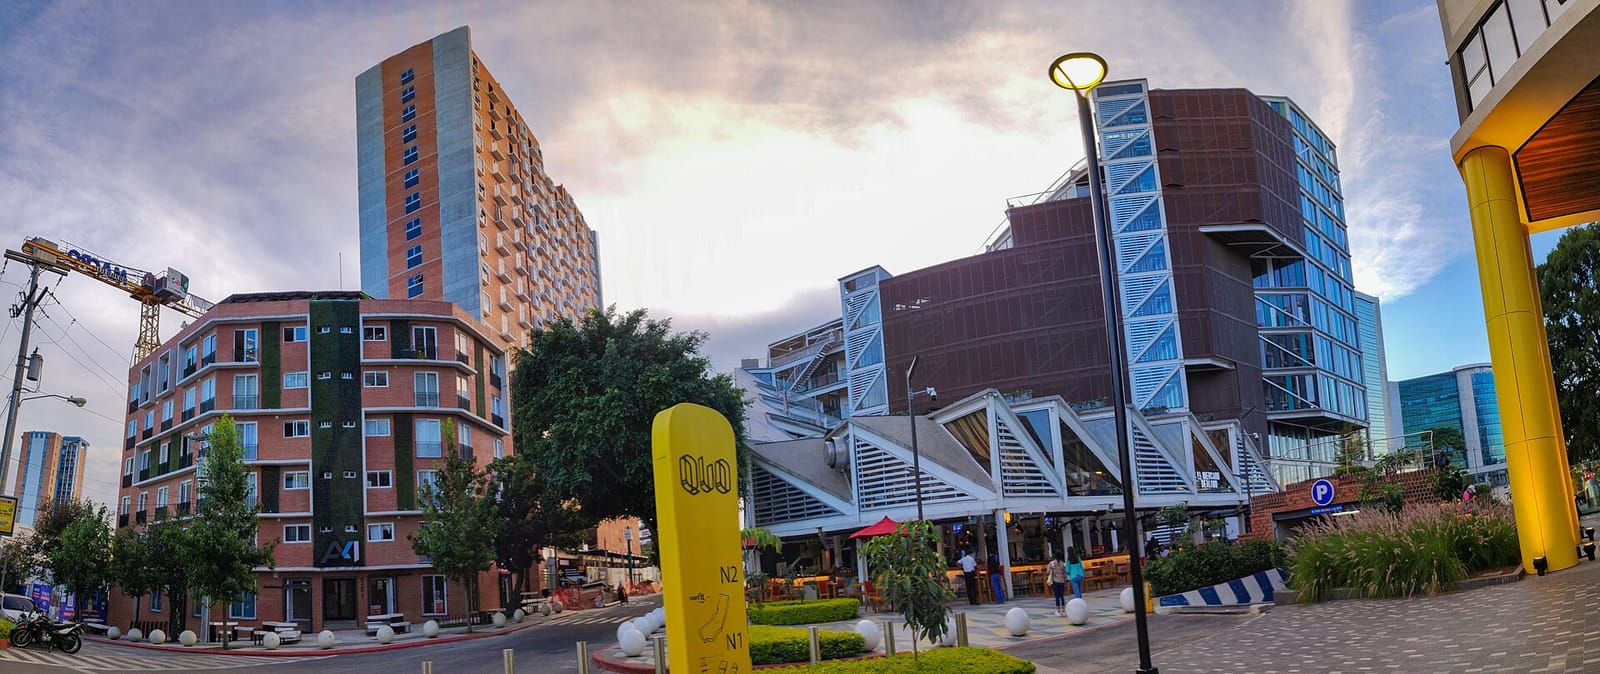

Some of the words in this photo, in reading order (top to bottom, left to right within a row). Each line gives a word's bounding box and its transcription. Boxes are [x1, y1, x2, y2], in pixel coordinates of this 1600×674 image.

[1316, 485, 1328, 500] P
[720, 566, 738, 584] N2
[726, 632, 743, 651] N1
